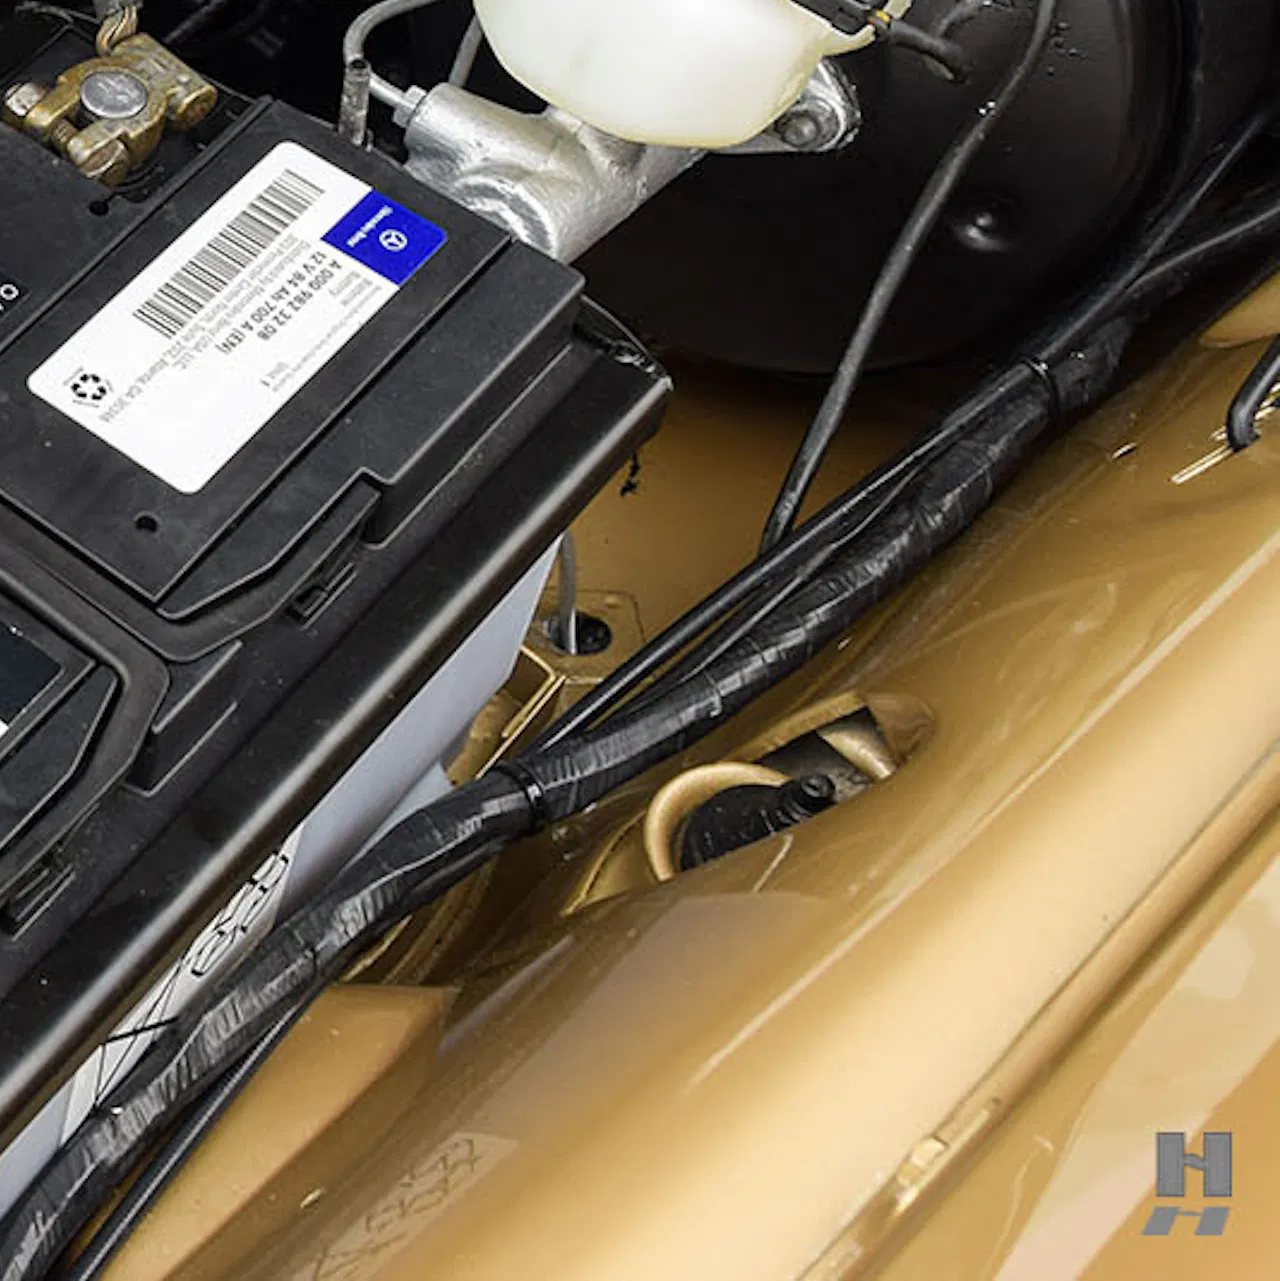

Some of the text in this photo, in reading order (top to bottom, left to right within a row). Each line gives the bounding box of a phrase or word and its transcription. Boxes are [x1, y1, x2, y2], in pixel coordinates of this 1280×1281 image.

[298, 260, 317, 275] V
[306, 267, 336, 292] 000
[247, 299, 278, 324] 700
[270, 308, 294, 327] 32
